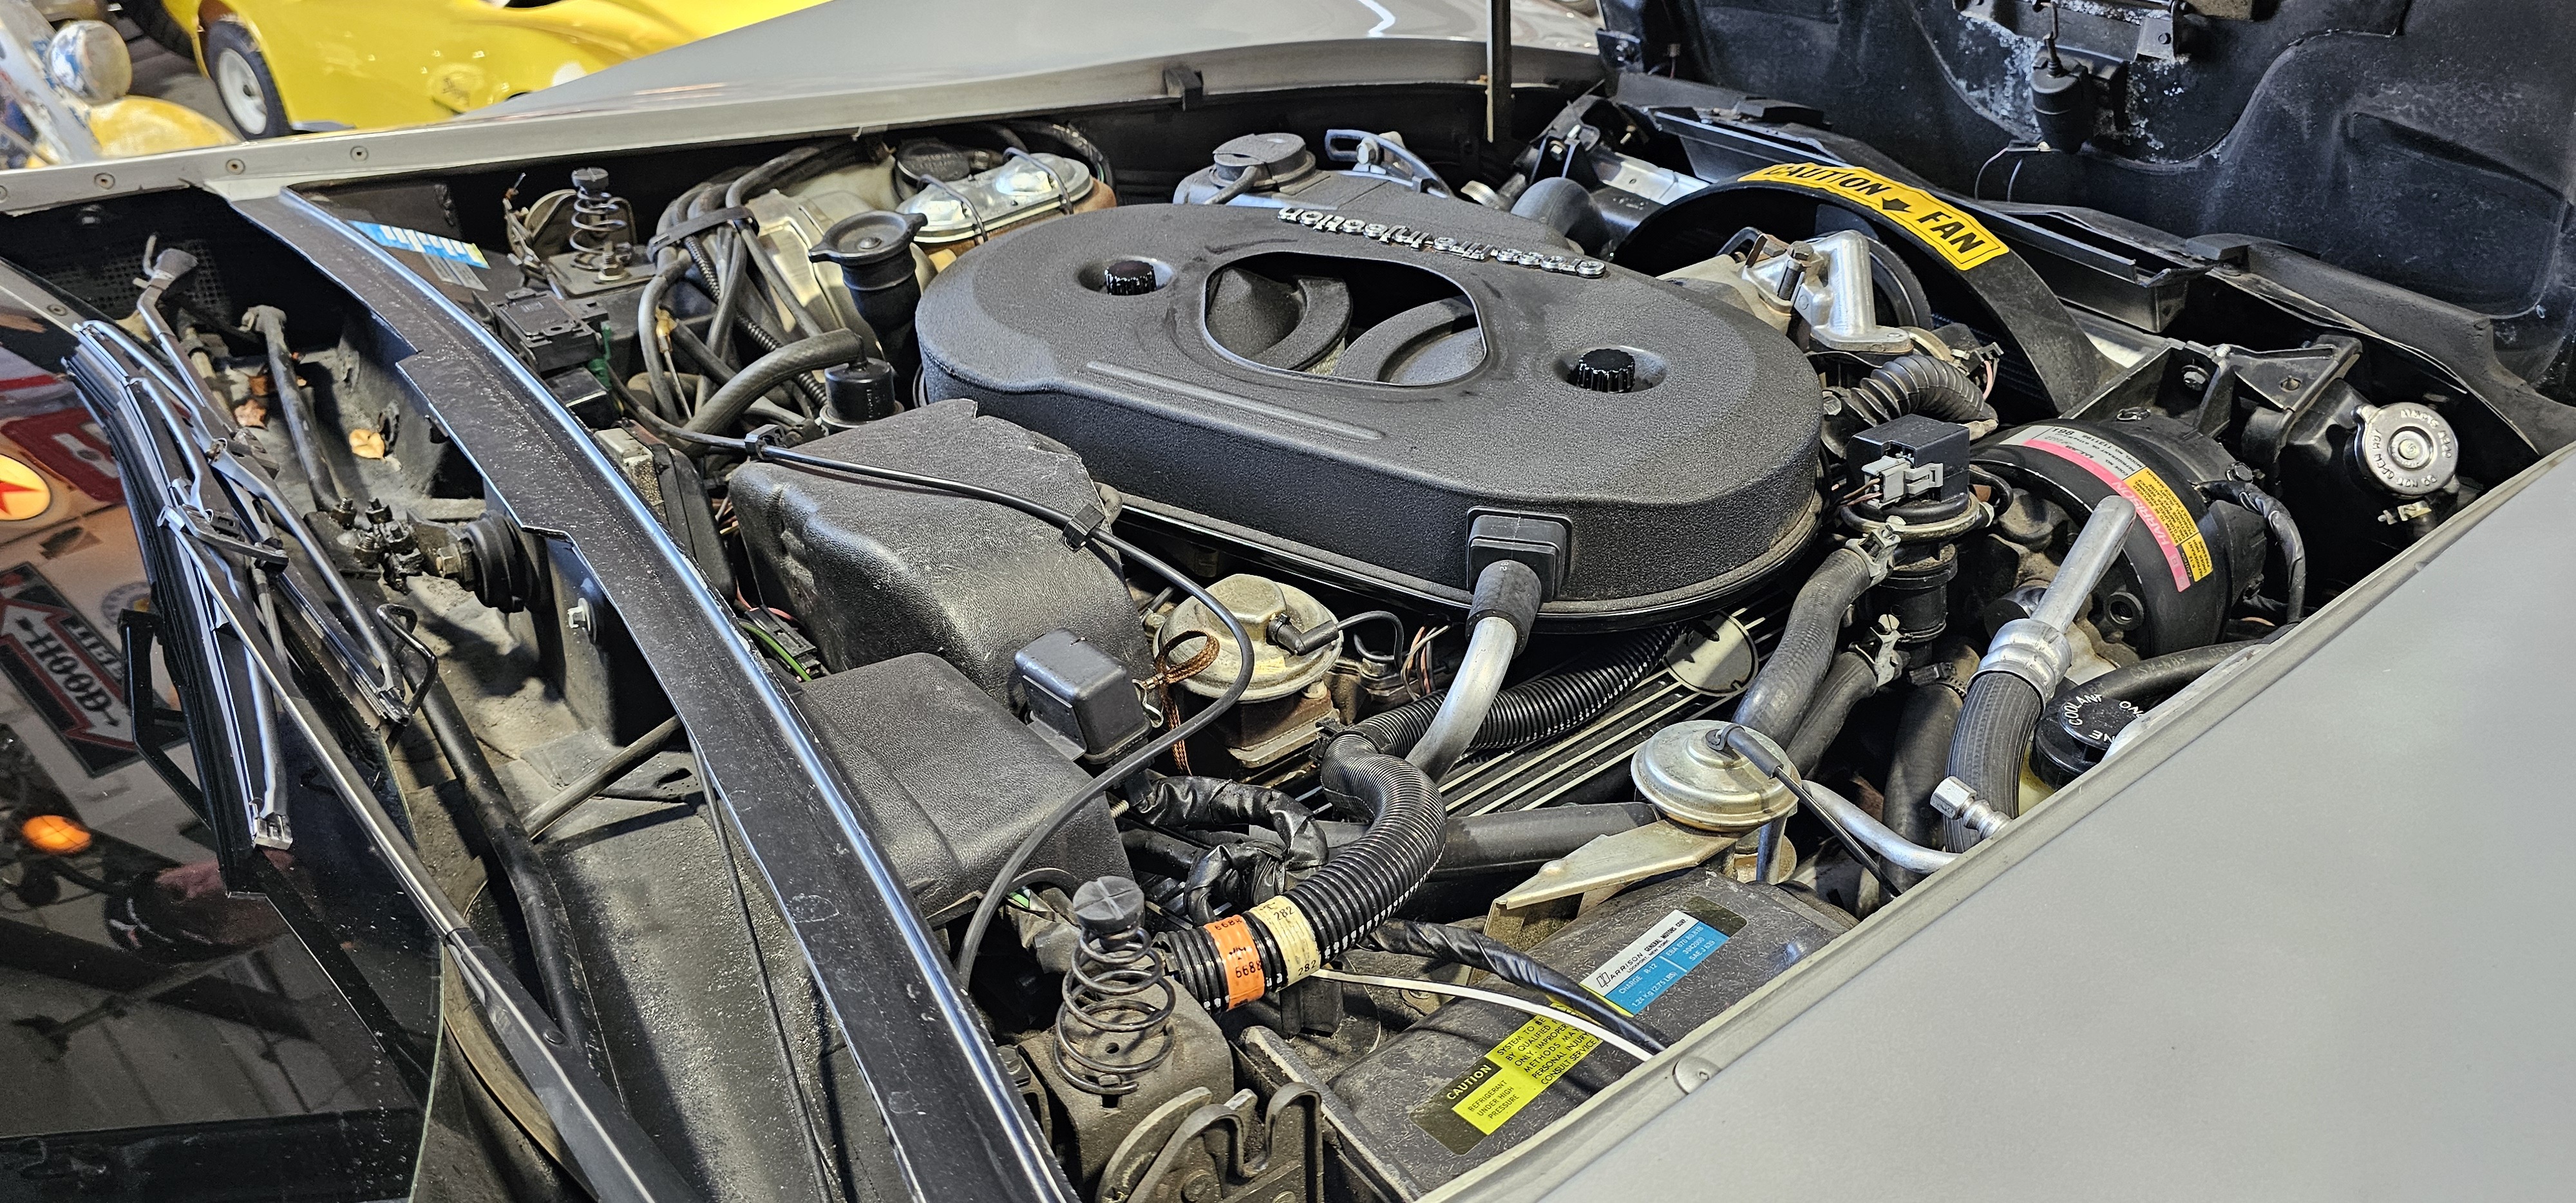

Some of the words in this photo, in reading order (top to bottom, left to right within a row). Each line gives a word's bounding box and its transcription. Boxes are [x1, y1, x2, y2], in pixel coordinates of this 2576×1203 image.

[1767, 166, 1892, 195] CAUTION
[1917, 211, 1985, 254] FAN
[2101, 449, 2136, 471] REFRIGERANT
[2114, 466, 2128, 476] CODE
[2374, 453, 2394, 479] OPEN
[2133, 485, 2154, 506] SERVICED
[2135, 480, 2159, 506] PERSONNEL
[2148, 484, 2163, 499] CAUSE
[2165, 489, 2181, 508] SERVICE
[2112, 481, 2170, 545] HARRISON
[2157, 498, 2176, 523] IMPROPER
[2159, 507, 2177, 534] QUALIFIED
[2175, 509, 2193, 535] PERSONAL
[2180, 509, 2195, 533] CONSULT
[2165, 523, 2179, 544] SYSTEM
[2172, 512, 2189, 537] METHODS
[2188, 542, 2203, 577] REFRIGERANT
[2199, 541, 2210, 567] PRESSURE
[2063, 694, 2102, 726] COOLANT
[1273, 905, 1296, 921] 282
[1644, 938, 1662, 952] GENERAL
[1649, 948, 1658, 957] NEW
[1689, 951, 1702, 961] SAE
[1235, 960, 1262, 978] 6688
[1298, 960, 1316, 976] 282
[1619, 975, 1643, 994] CHARGE
[1643, 963, 1658, 974] R-12
[1497, 1035, 1524, 1056] SYSTEM
[1522, 1026, 1535, 1036] TO
[1535, 1017, 1546, 1026] BE
[1506, 1052, 1516, 1061] BY
[1518, 1025, 1551, 1052] QUALIFIED
[1537, 1024, 1569, 1049] IMPROPER
[1523, 1042, 1560, 1073] METHODS
[1562, 1028, 1579, 1043] MAY
[1531, 1051, 1567, 1079] PERSONAL
[1566, 1032, 1589, 1051] INJURY
[1540, 1059, 1572, 1085] CONSULT
[1569, 1039, 1597, 1061] SERVICE
[1446, 1064, 1492, 1100] CAUTION
[1468, 1079, 1507, 1112] REFRIGERANT
[1476, 1098, 1499, 1117] UNDER
[1497, 1086, 1514, 1099] HIGH
[1488, 1094, 1520, 1119] PRESSURE
